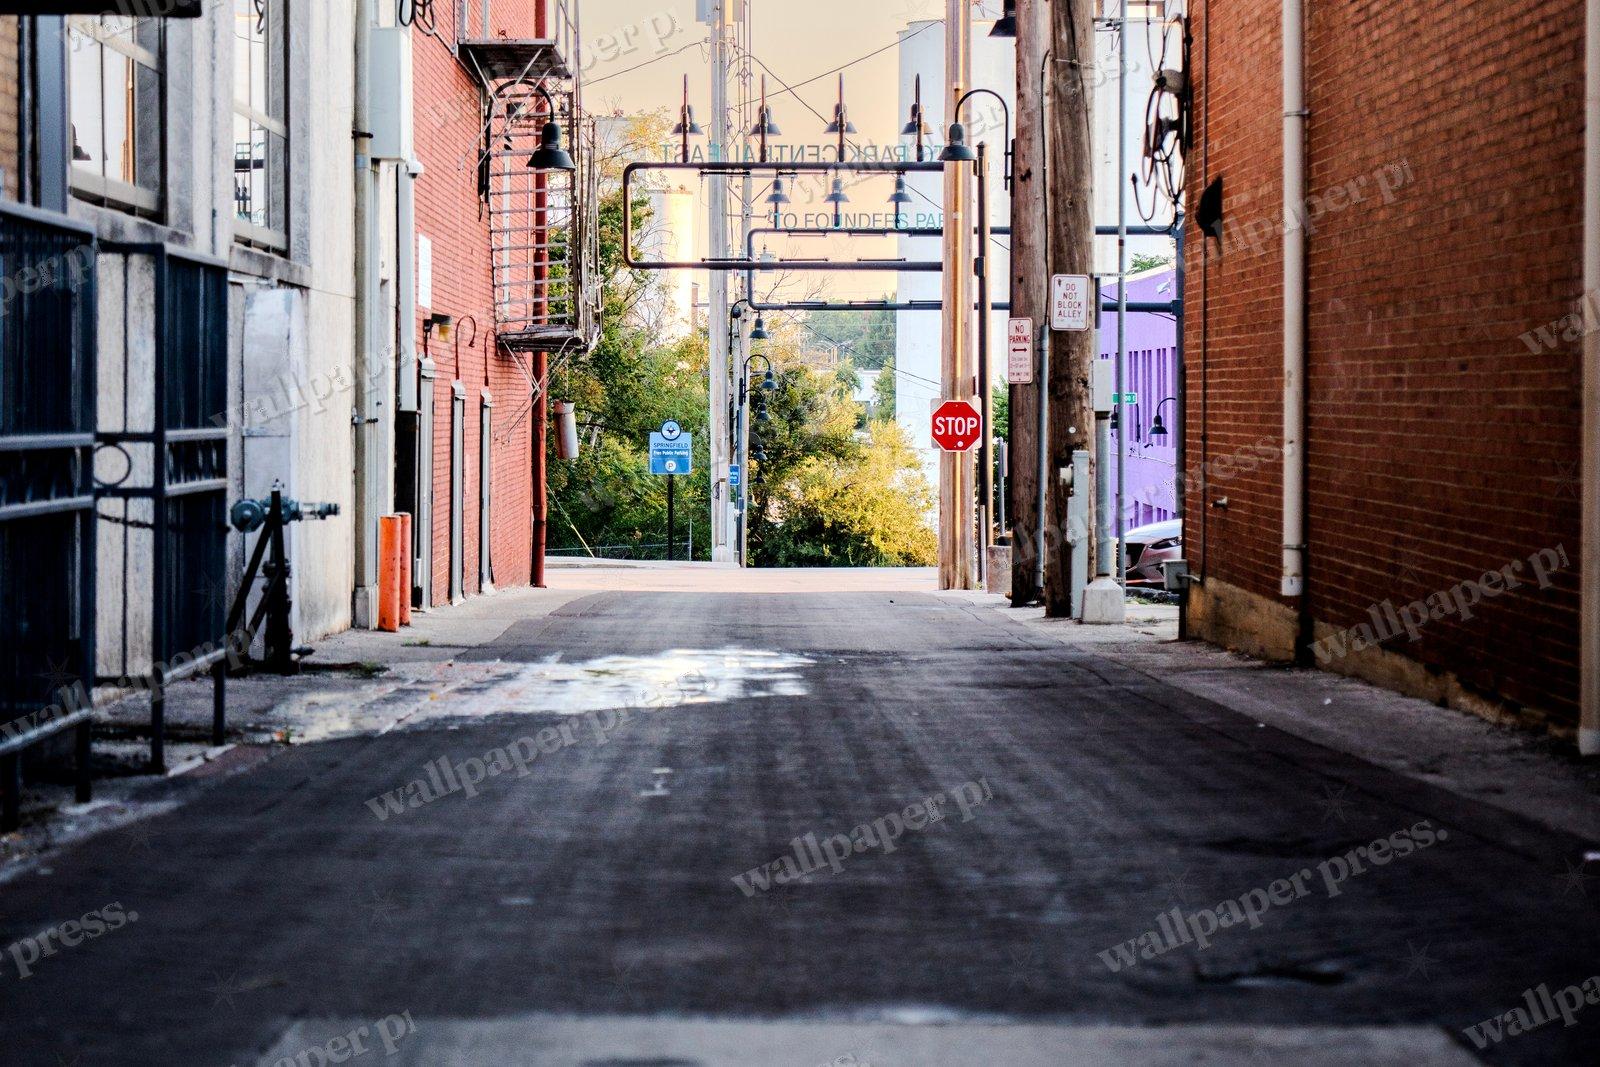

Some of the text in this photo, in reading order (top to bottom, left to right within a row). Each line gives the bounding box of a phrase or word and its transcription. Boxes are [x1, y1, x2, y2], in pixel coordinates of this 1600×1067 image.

[773, 212, 798, 229] TO
[804, 212, 909, 229] FOUNDERS
[1065, 283, 1076, 292] DO
[1062, 292, 1078, 301] NOT
[1057, 300, 1082, 309] BLOCK
[1057, 310, 1082, 318] ALLEY
[1015, 325, 1025, 334] NO
[1009, 335, 1031, 343] PARKING
[934, 416, 978, 436] STOP
